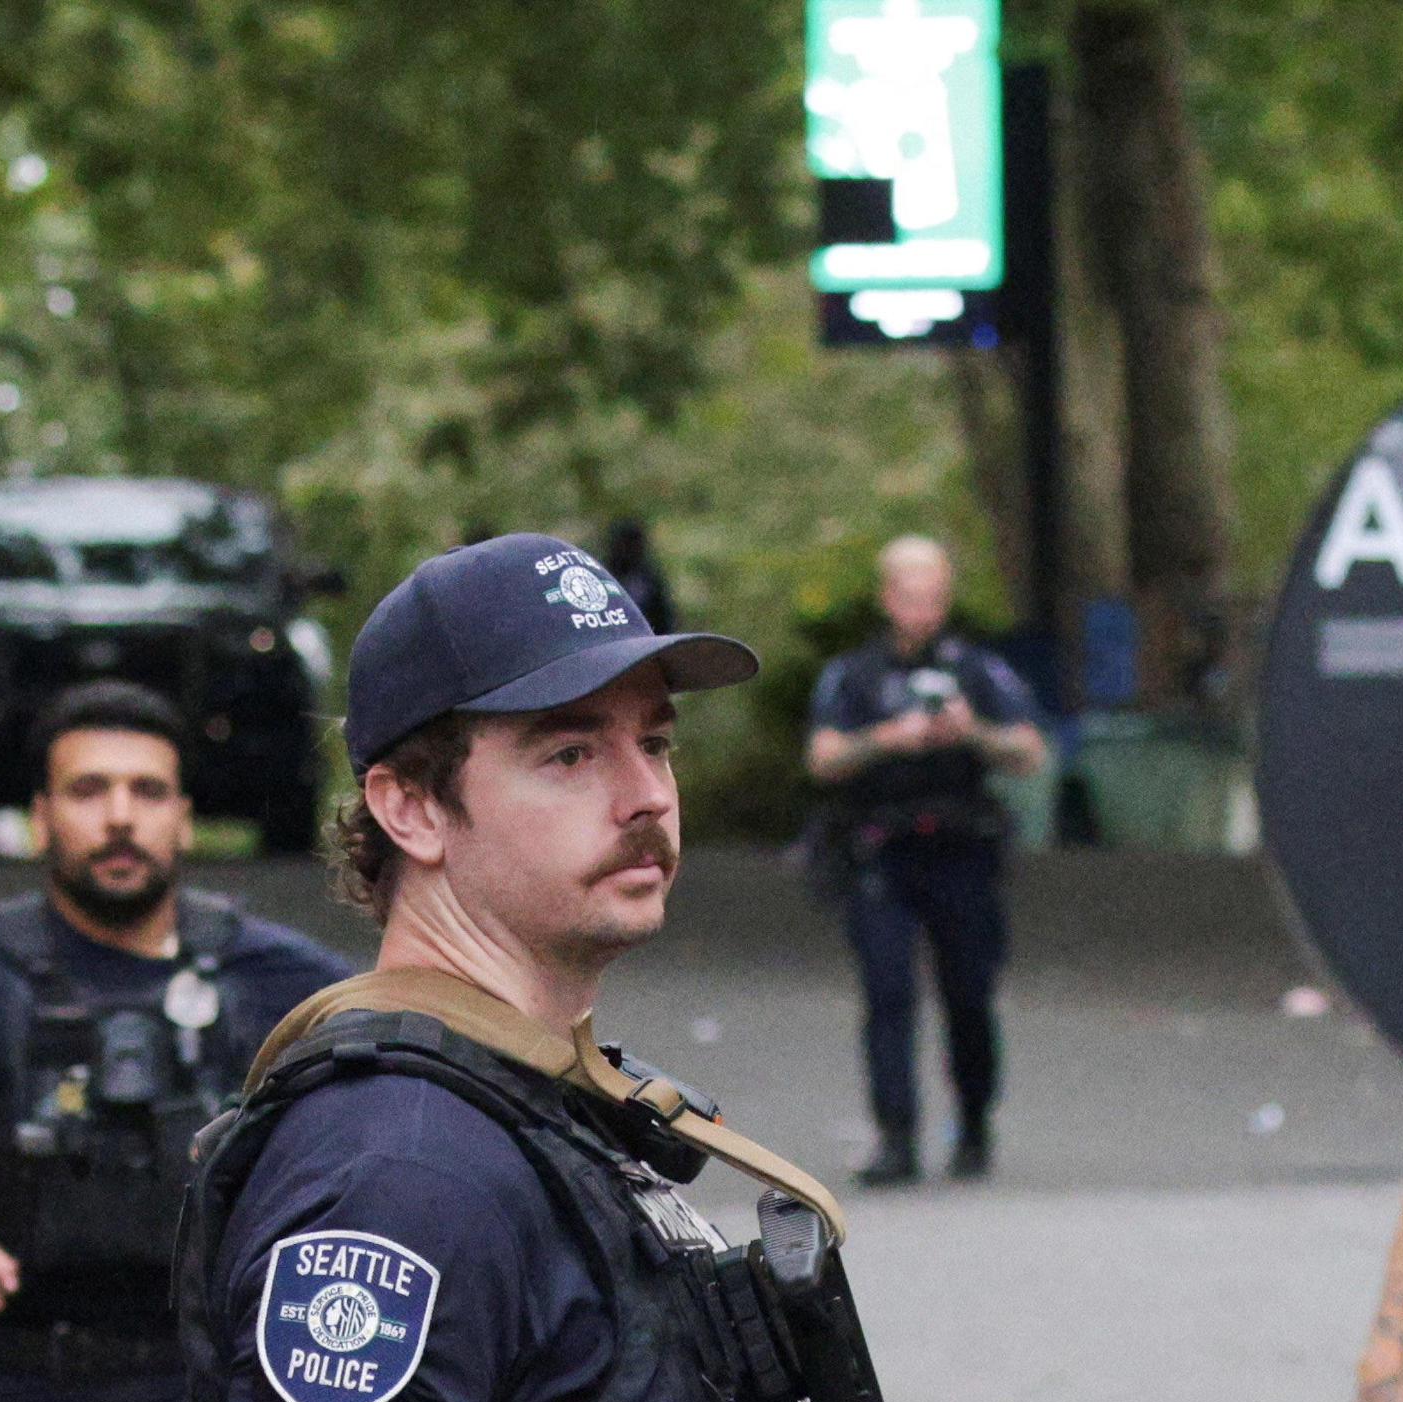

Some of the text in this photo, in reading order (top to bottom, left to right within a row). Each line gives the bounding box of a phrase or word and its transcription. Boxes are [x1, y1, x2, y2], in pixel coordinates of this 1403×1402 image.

[571, 608, 629, 629] POLICE
[296, 1244, 416, 1297] SEATTLE
[310, 1286, 344, 1317] SERVICE
[355, 1291, 377, 1318] PRIDE
[312, 1326, 367, 1350] DEDICATION
[380, 1321, 407, 1340] 1869
[287, 1348, 379, 1394] POLICE
